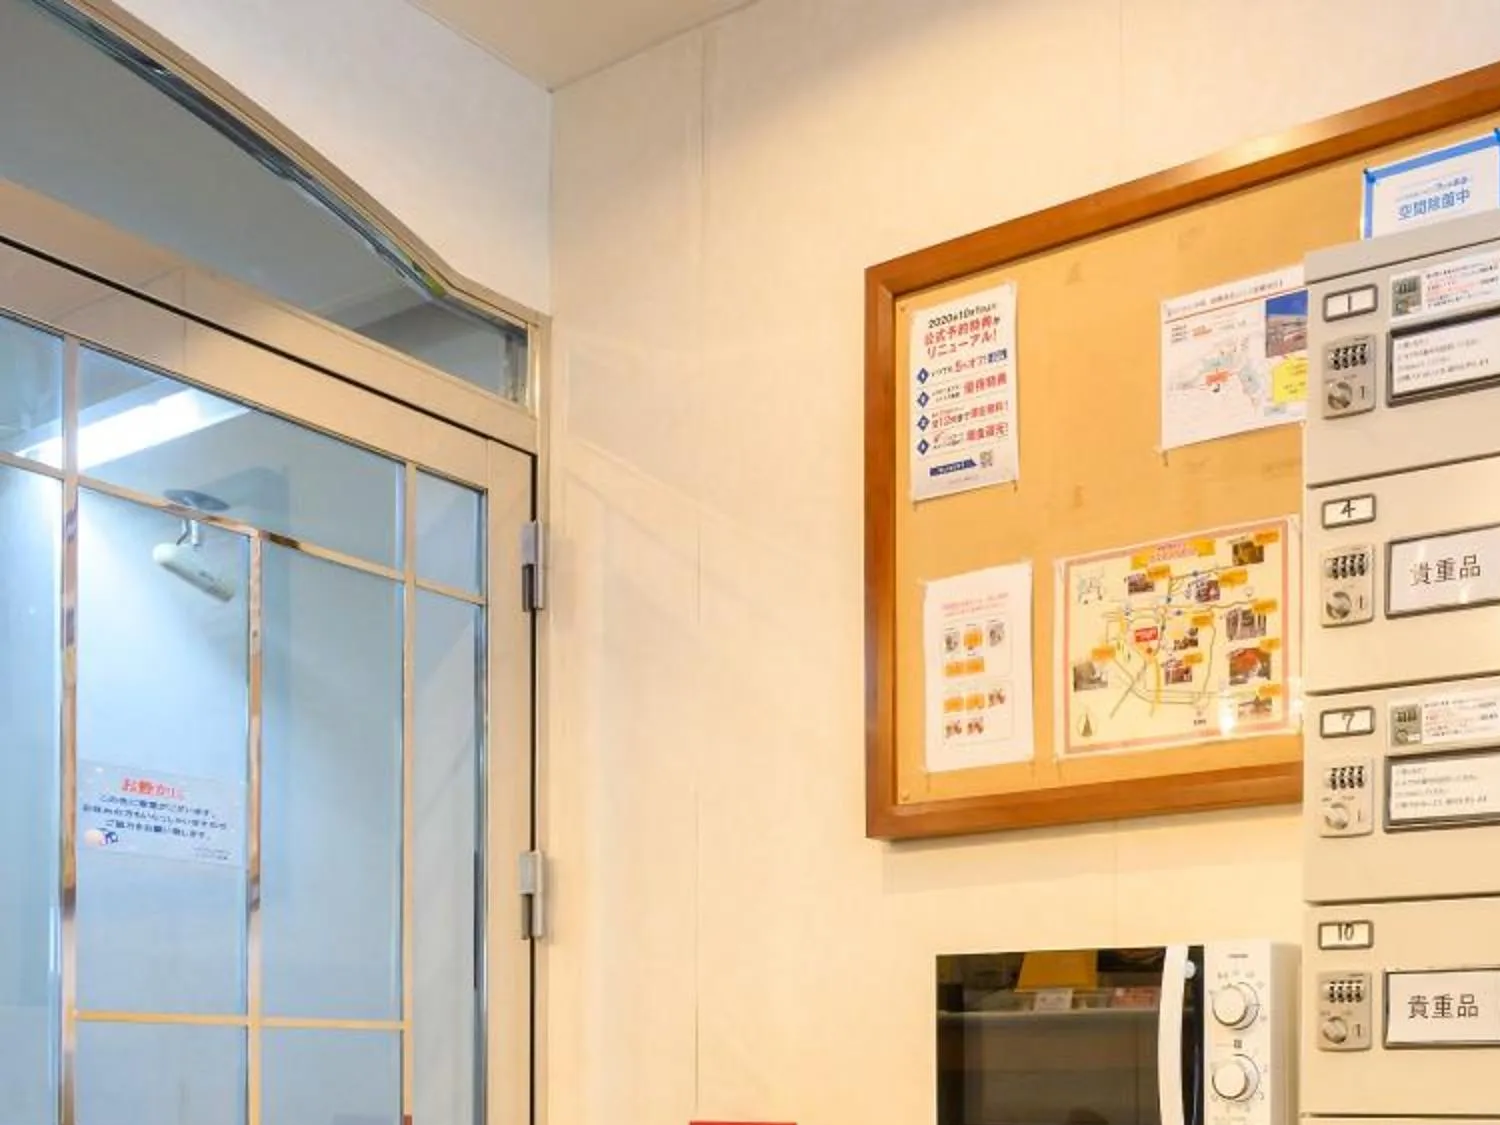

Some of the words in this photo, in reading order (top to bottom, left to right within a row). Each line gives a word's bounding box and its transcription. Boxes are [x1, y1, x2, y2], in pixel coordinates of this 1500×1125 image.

[1341, 499, 1356, 518] 4
[1410, 554, 1481, 586] 貴重品
[1341, 712, 1354, 730] 7
[1338, 923, 1354, 941] 10
[1407, 993, 1479, 1019] 貴重品
